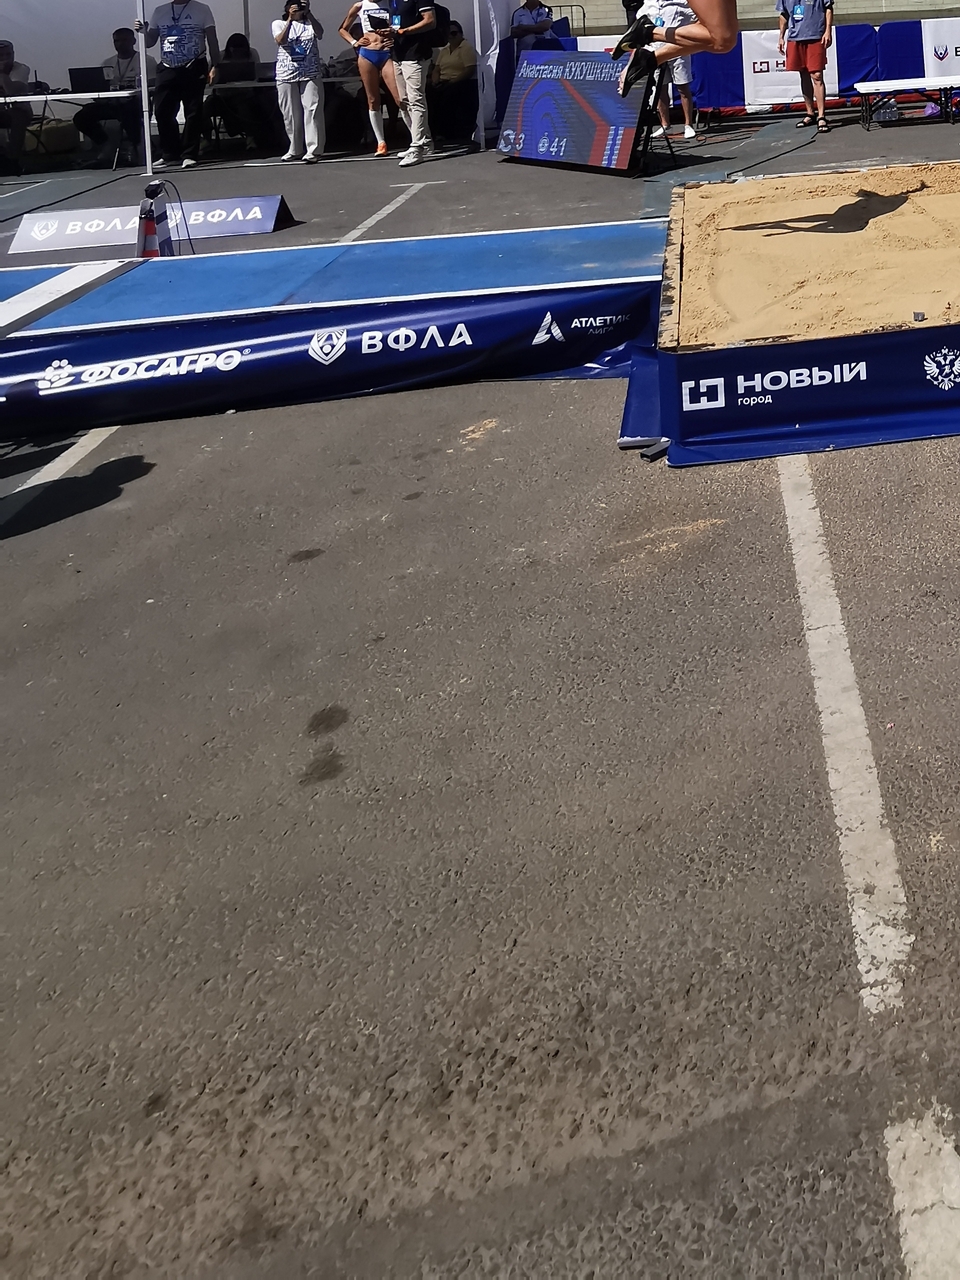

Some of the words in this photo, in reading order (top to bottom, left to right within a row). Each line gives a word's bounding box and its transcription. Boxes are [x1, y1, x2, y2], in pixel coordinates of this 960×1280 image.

[518, 60, 563, 78] Анастасия
[564, 61, 623, 82] КУКУШКИНА
[516, 132, 525, 150] 3
[549, 137, 567, 156] 41
[188, 206, 263, 225] ВФЛА
[65, 216, 140, 235] ВФЛА
[570, 314, 630, 329] АТЛЕТИК
[361, 323, 473, 354] ВФЛА
[80, 349, 242, 384] ФОСАГРО
[737, 361, 867, 394] НОВЫЙ
[737, 394, 773, 406] город
